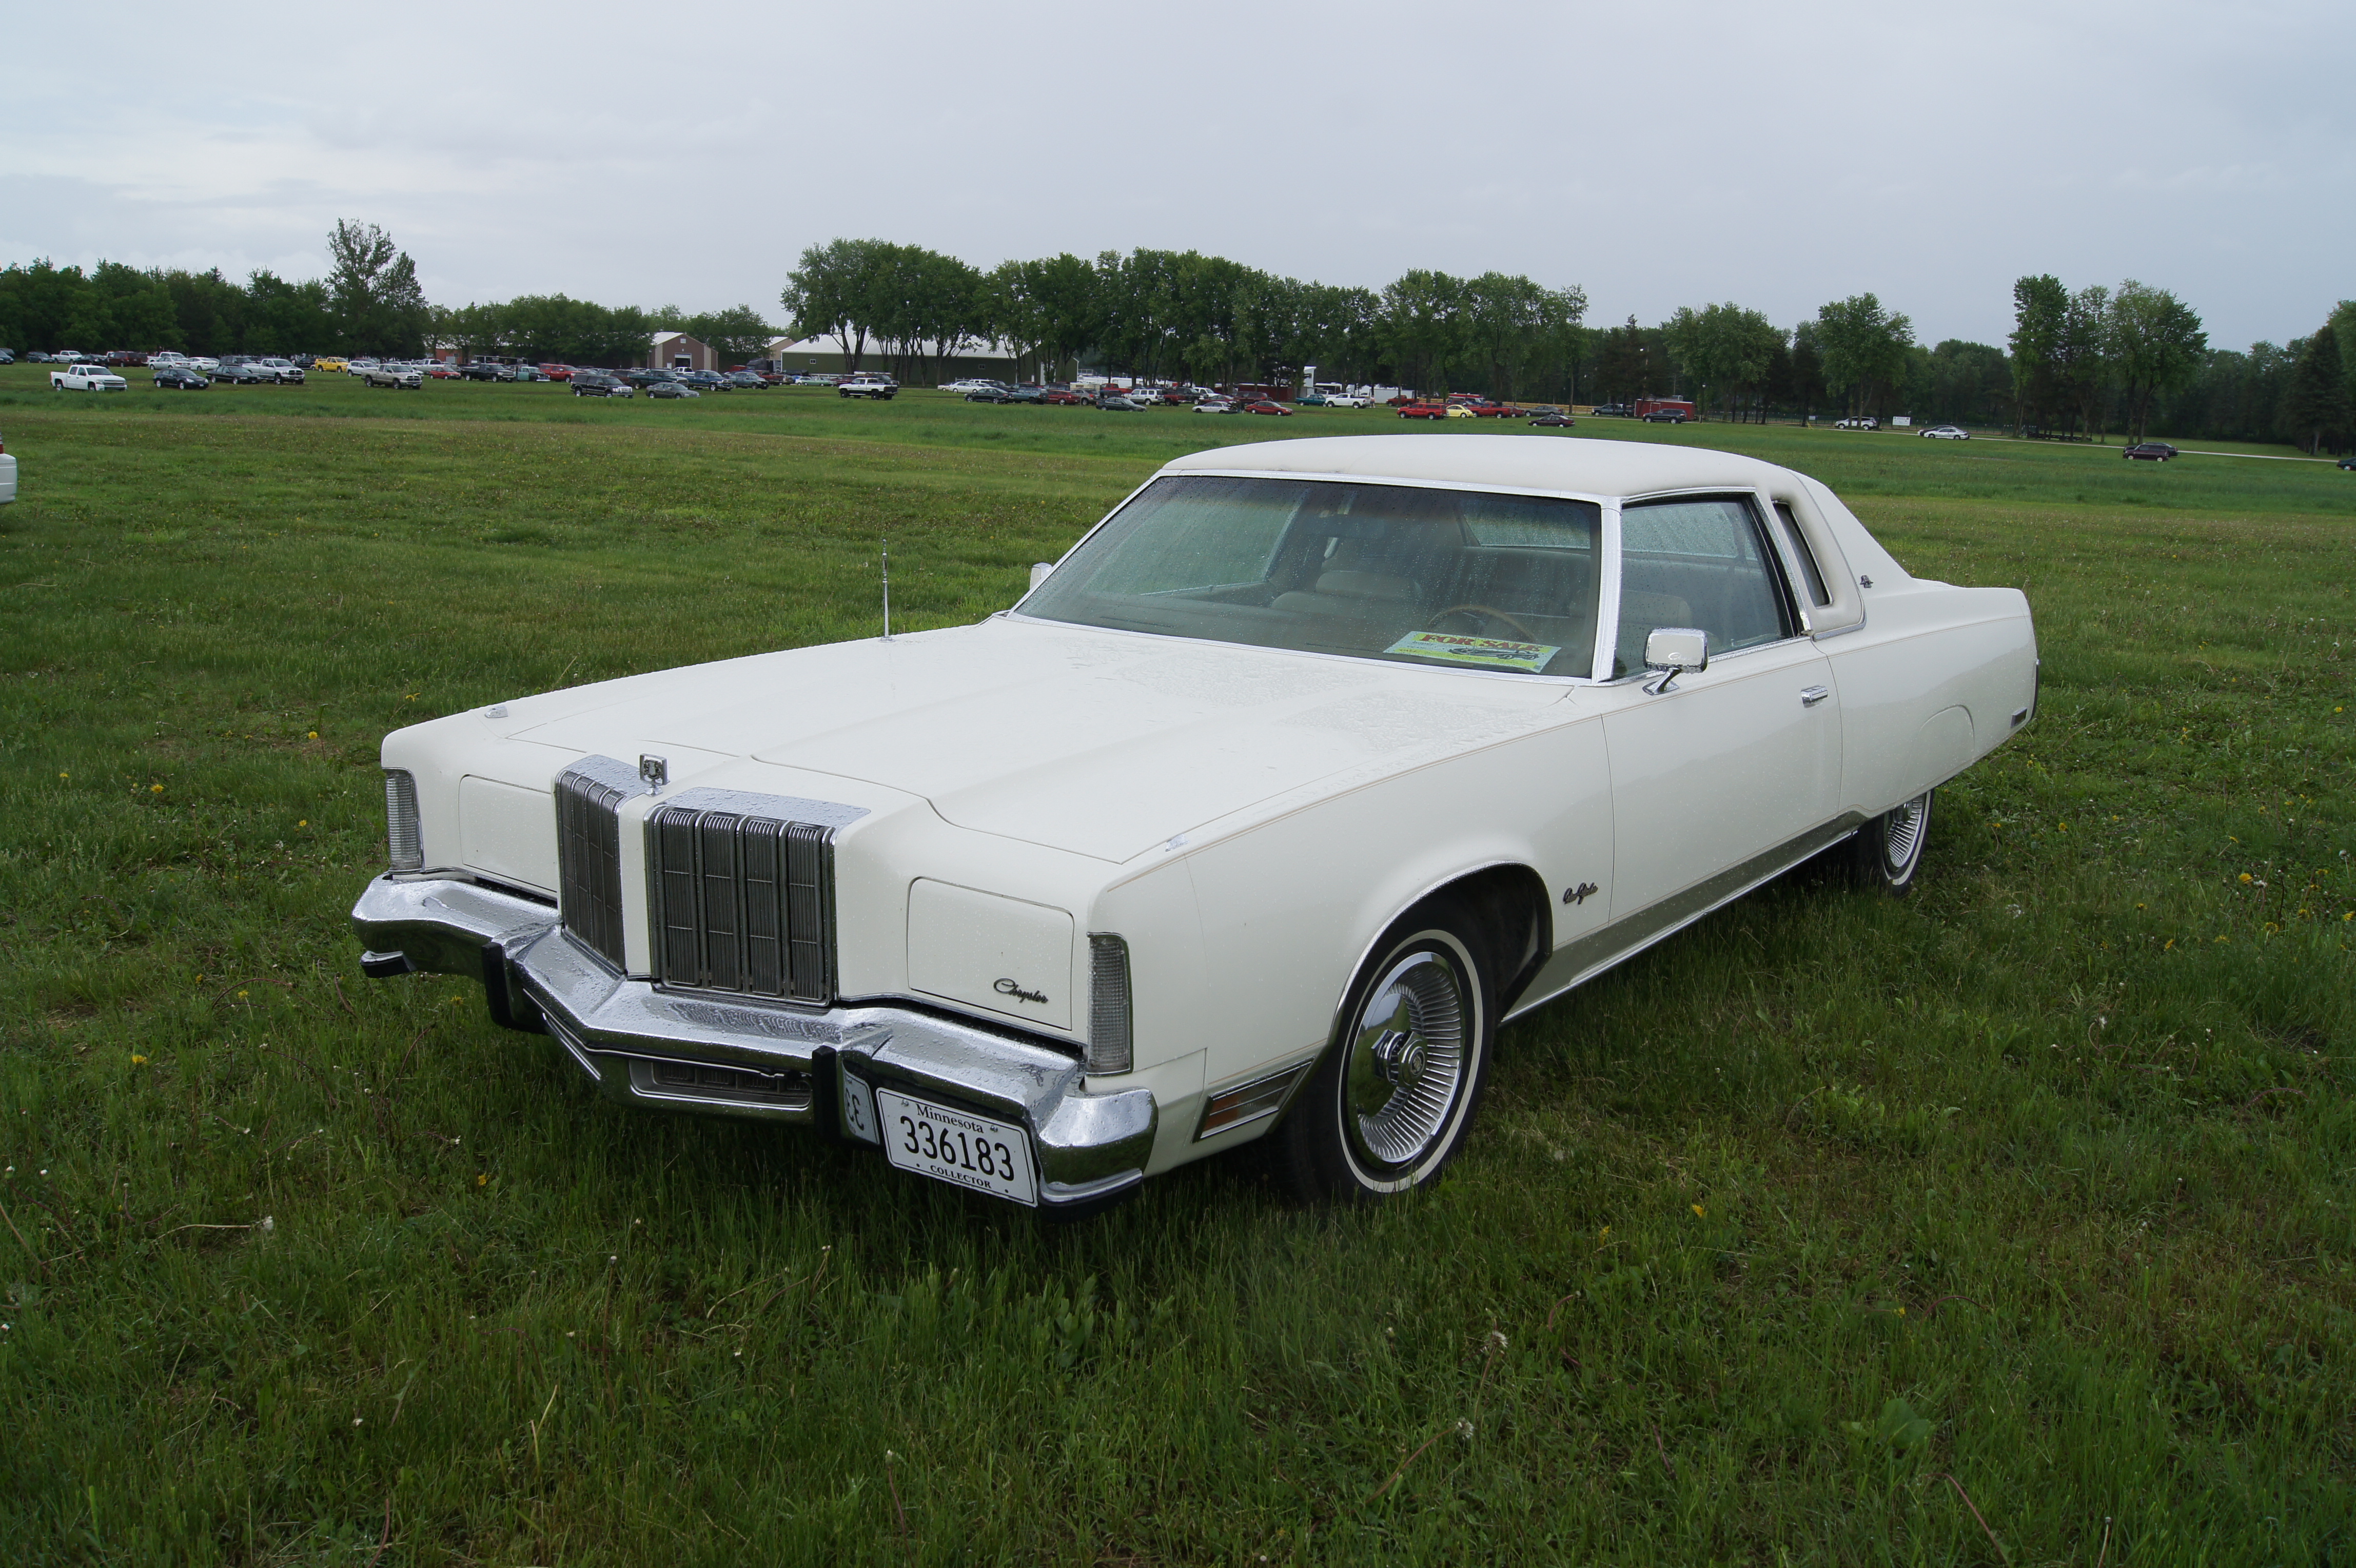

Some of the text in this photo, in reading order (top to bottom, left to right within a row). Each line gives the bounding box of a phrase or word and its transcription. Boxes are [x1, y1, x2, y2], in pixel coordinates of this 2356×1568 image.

[1419, 635, 1475, 645] FOR
[1479, 640, 1543, 652] SALE
[993, 977, 1048, 1004] Chrysler
[915, 1103, 984, 1133] Minnesota
[900, 1115, 1014, 1181] 336183
[930, 1165, 991, 1189] COLLECTOR
